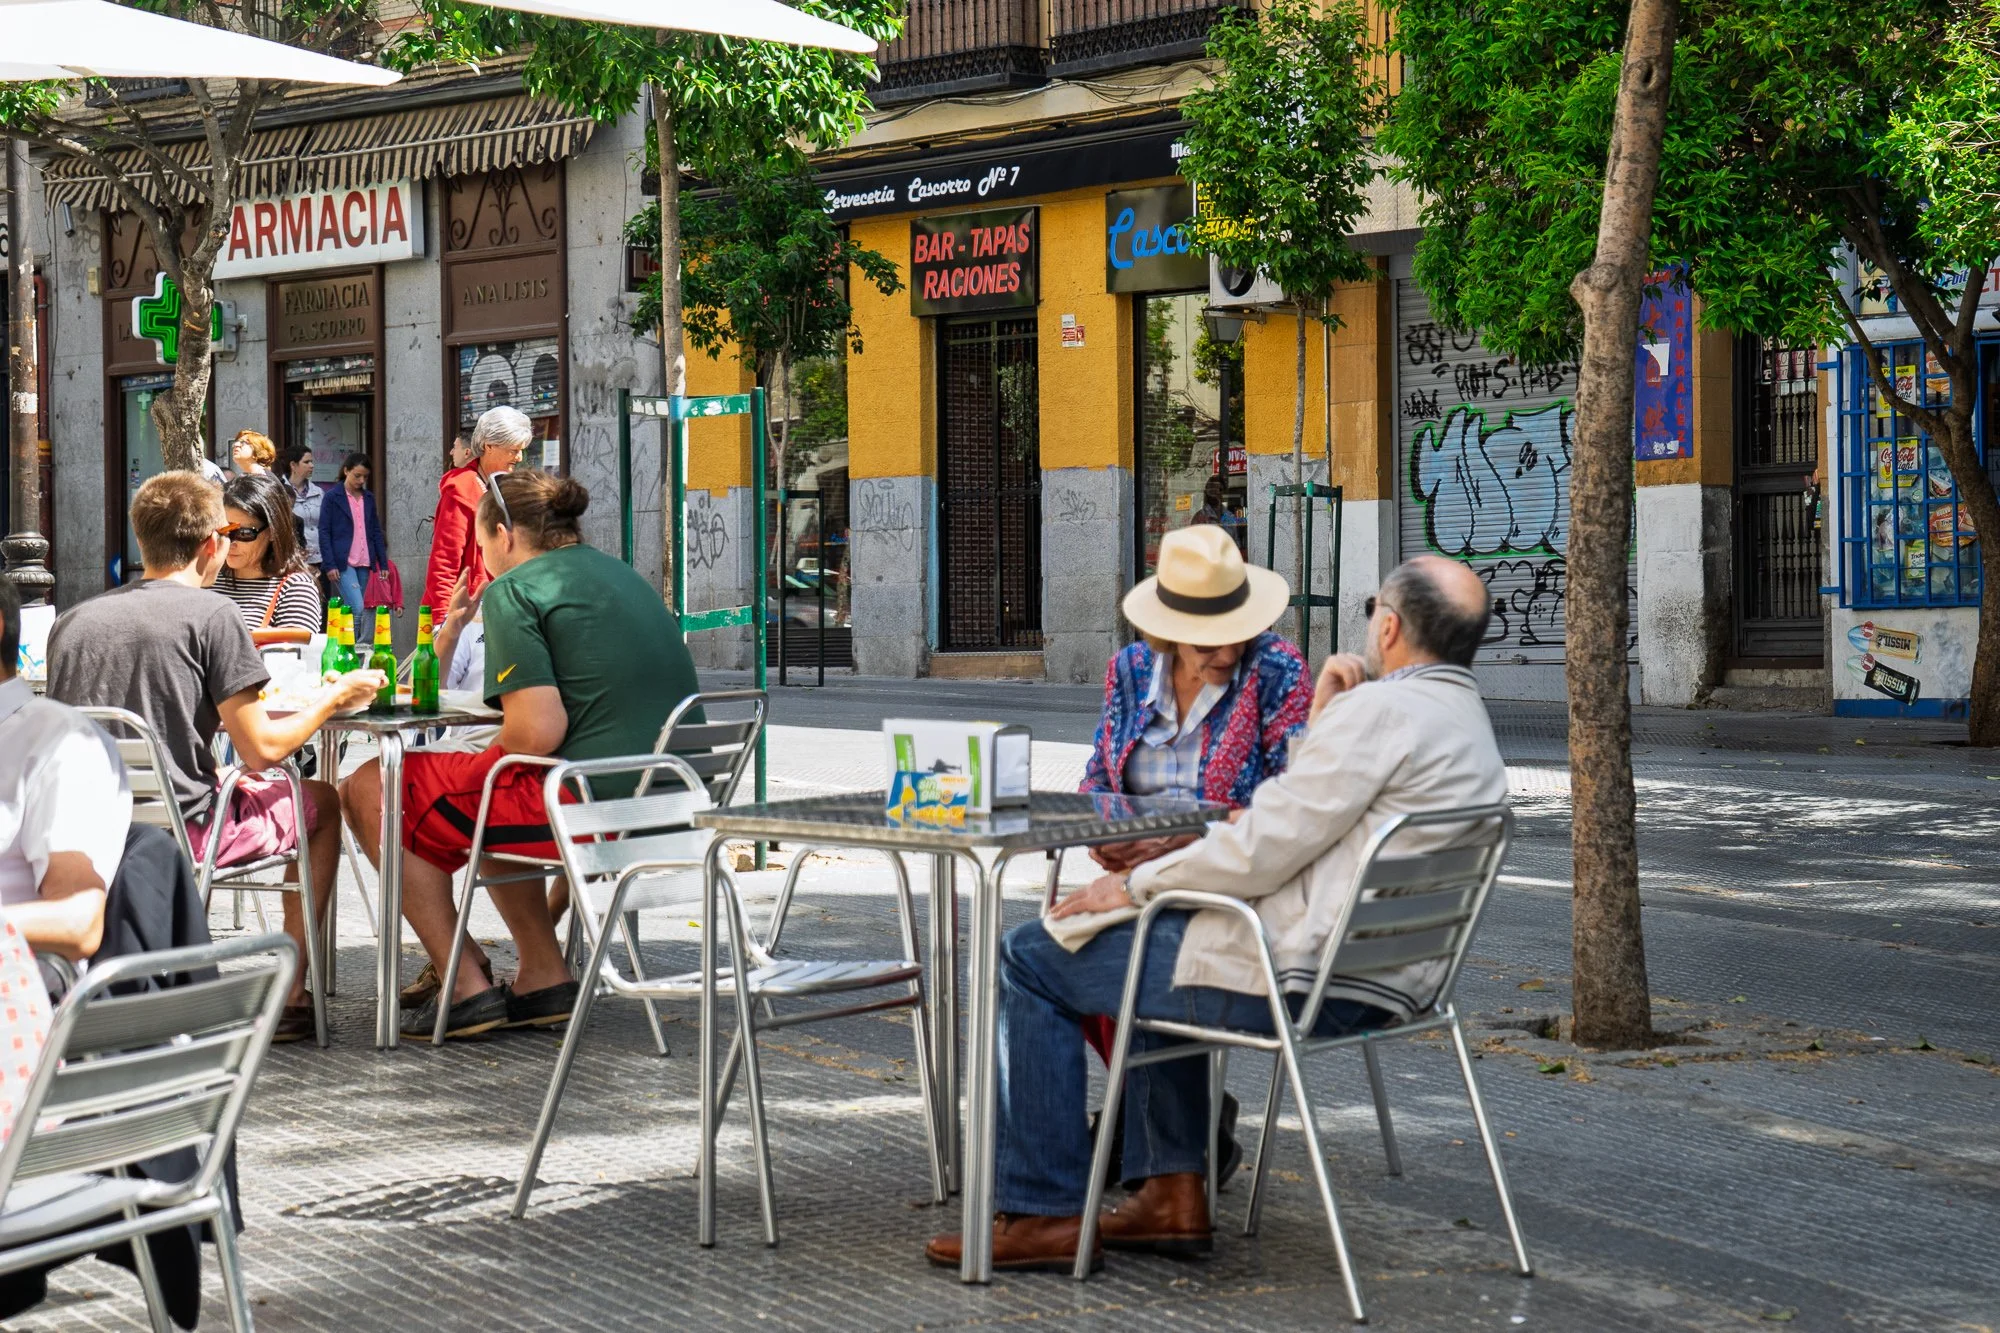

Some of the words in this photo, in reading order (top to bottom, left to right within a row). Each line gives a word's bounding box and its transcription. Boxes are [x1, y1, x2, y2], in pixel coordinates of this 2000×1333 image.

[908, 177, 971, 202] Cascorro
[1010, 166, 1020, 186] 7
[227, 186, 408, 261] ARMACIA
[914, 231, 955, 263] BAR
[970, 223, 1030, 257] TAPAS
[1108, 207, 1192, 270] Casco
[284, 282, 370, 316] FARMACIA
[464, 278, 549, 306] ANALISIS
[923, 262, 1021, 300] RACIONES
[1674, 300, 1687, 459] NATURALEZA
